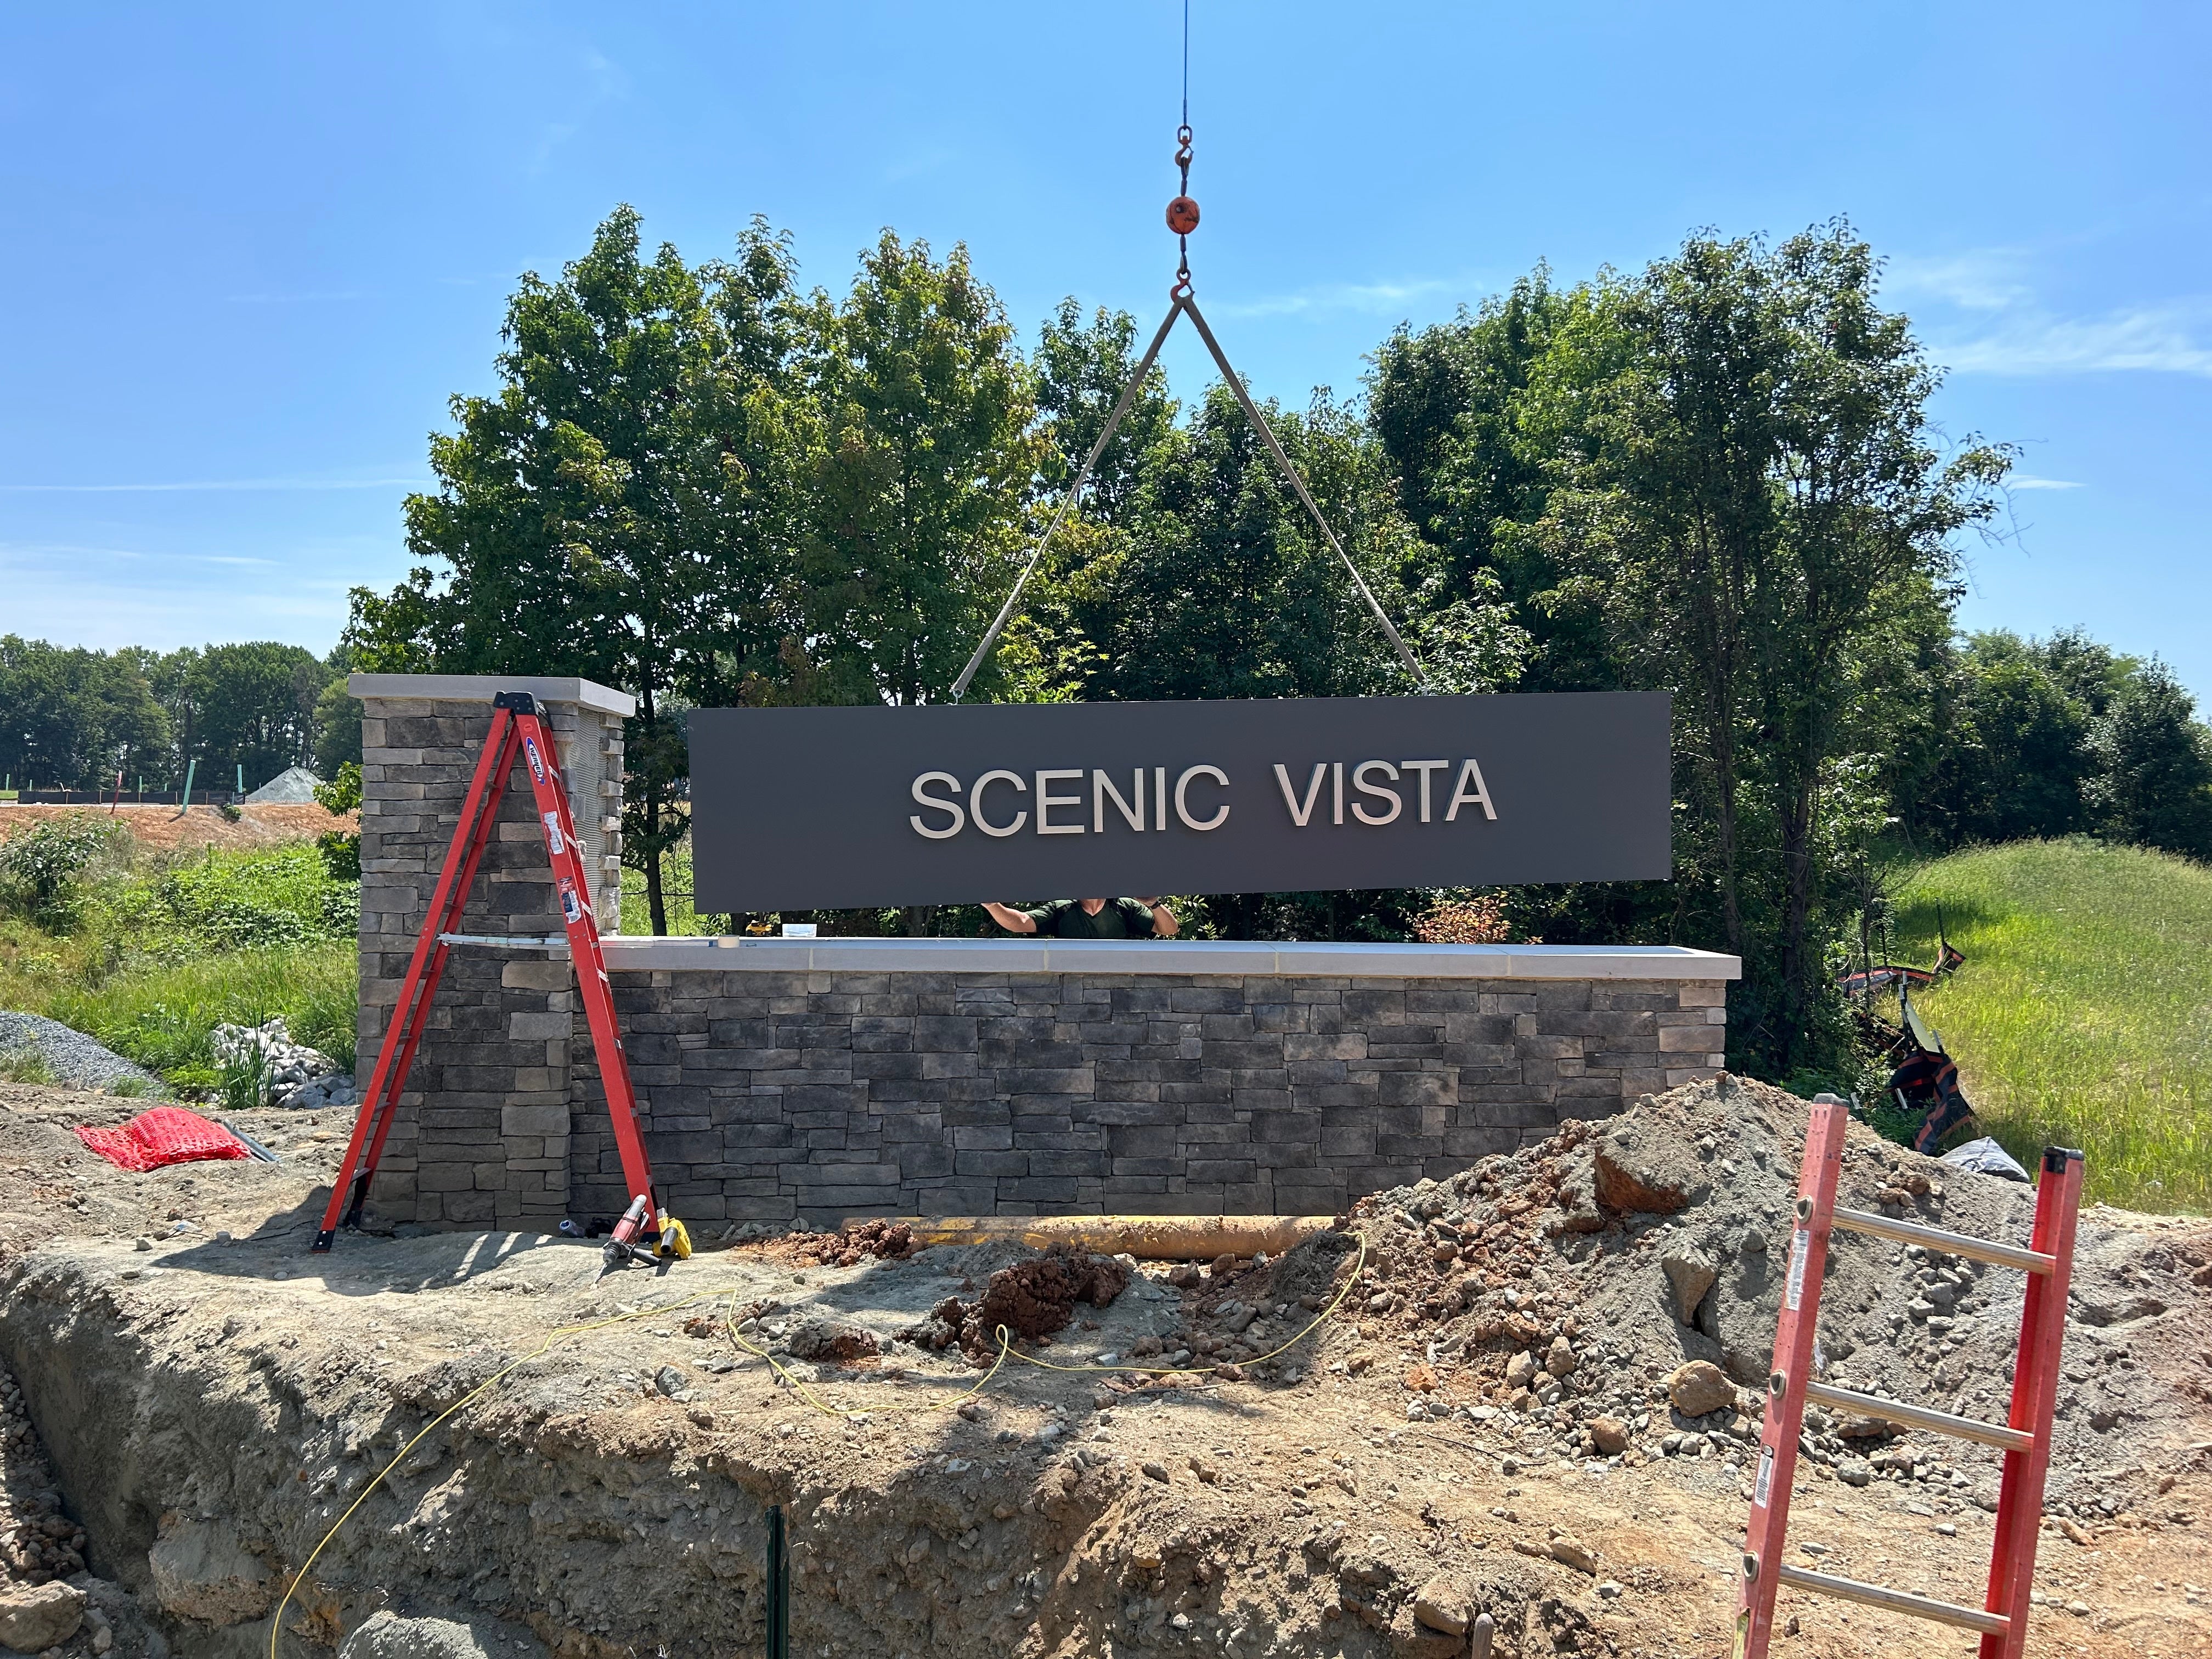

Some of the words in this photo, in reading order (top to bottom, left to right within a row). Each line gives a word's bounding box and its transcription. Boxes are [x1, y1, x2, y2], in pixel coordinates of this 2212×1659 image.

[529, 747, 543, 775] WERNER
[909, 764, 1231, 839] SCENIC
[1273, 758, 1498, 827] VISTA
